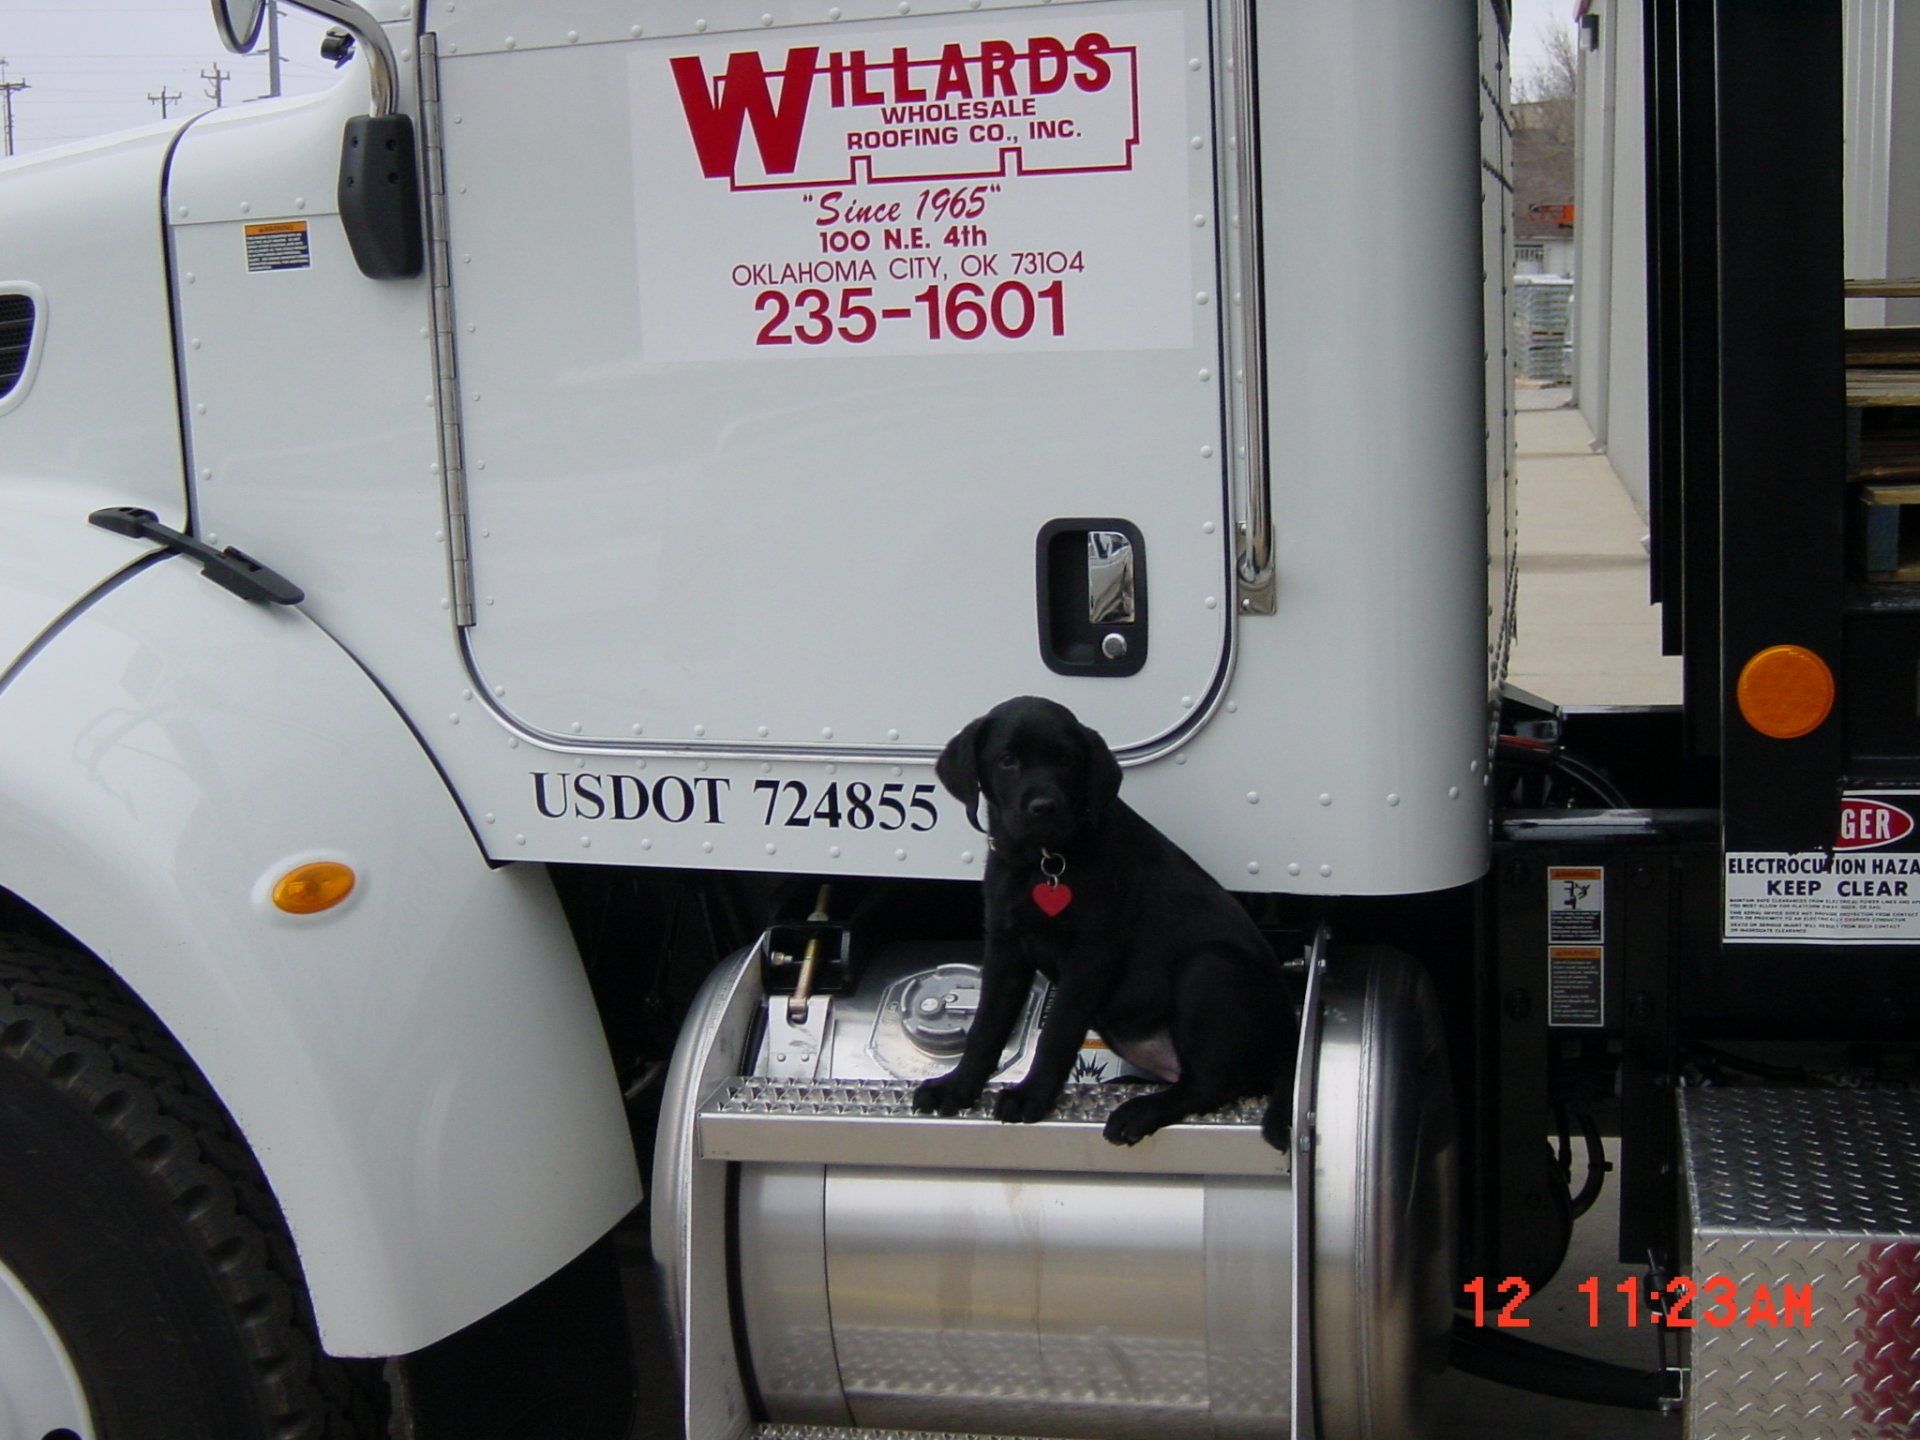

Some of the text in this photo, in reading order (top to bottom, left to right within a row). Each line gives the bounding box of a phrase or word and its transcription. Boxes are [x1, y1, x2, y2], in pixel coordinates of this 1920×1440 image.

[669, 33, 1111, 179] WILLARDS
[881, 99, 1037, 125] WHOLESALE
[846, 119, 1083, 151] ROOFING CO., INC.
[819, 225, 987, 253] 100 N.E. 4th
[732, 250, 1086, 287] OKLAHOMA CITY, OK 73104
[754, 279, 1066, 346] 235-1601
[529, 771, 732, 825] USDOT
[752, 779, 940, 833] 724855
[1841, 808, 1891, 840] GER
[1872, 858, 1920, 875] HAZA
[1767, 880, 1908, 897] KEEP CLEAR
